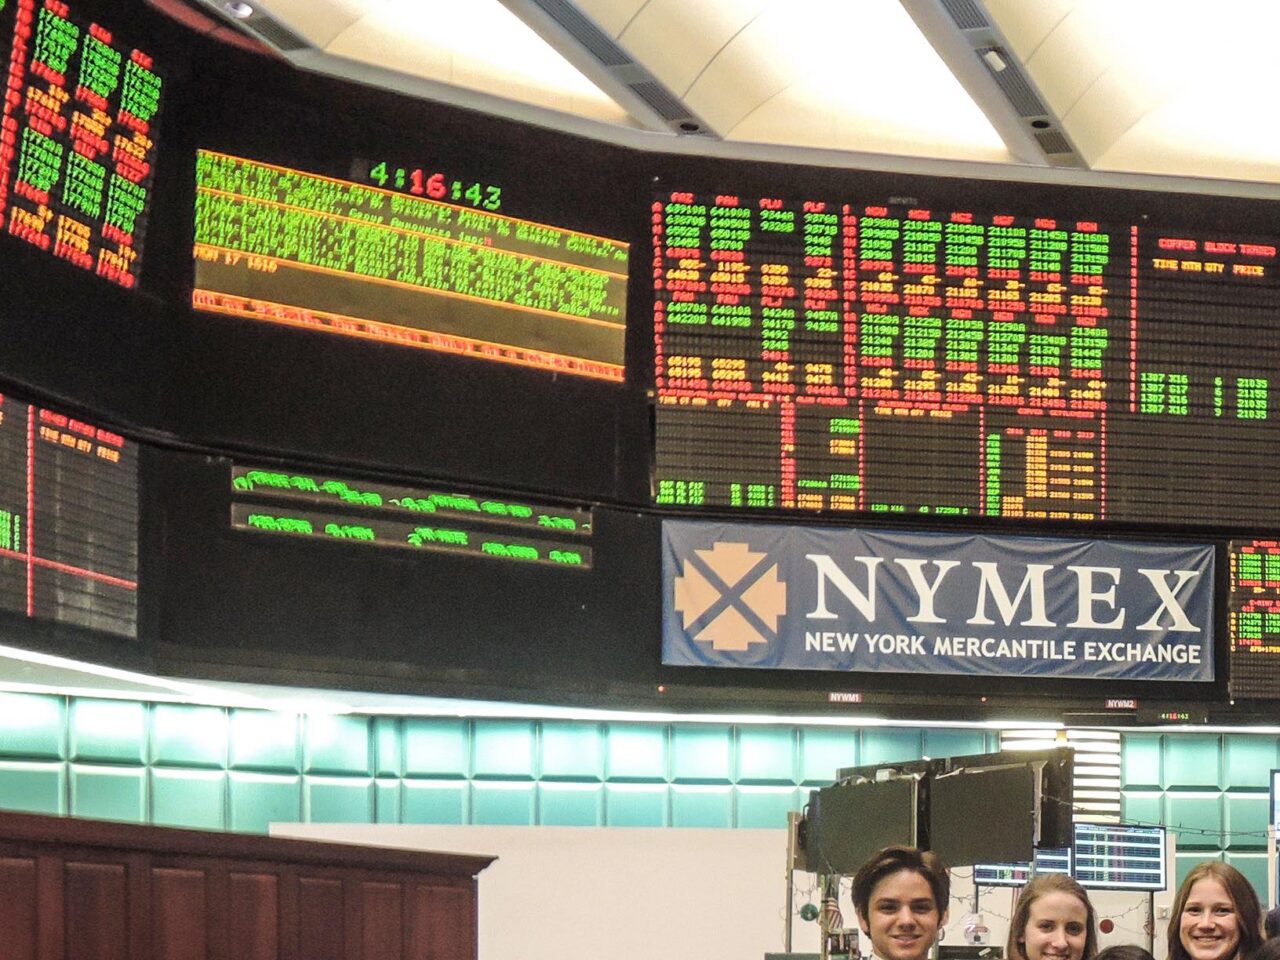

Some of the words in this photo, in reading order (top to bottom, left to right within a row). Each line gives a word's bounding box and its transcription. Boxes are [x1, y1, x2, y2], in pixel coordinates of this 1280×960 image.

[370, 162, 500, 211] 4:16:43
[905, 219, 942, 232] 21015A
[989, 225, 1026, 238] 21110A
[1031, 239, 1068, 251] 21120B
[1072, 242, 1109, 254] 21150B
[904, 251, 936, 264] 21015
[1072, 263, 1103, 275] 21135
[1072, 252, 1108, 265] 21315B
[1152, 258, 1178, 269] TIME
[1233, 264, 1264, 276] PRICE
[762, 329, 789, 341] 9492
[989, 321, 1028, 334] 21290A
[904, 326, 942, 339] 21215B
[946, 329, 984, 341] 21245B
[988, 331, 1026, 344] 21270B
[1071, 336, 1109, 349] 21315B
[861, 334, 892, 347] 21240
[989, 342, 1020, 354] 21345
[1030, 344, 1062, 357] 21370
[1071, 347, 1103, 359] 21445
[862, 345, 893, 357] 21240
[1030, 355, 1061, 367] 21370
[1071, 357, 1102, 369] 21365
[1140, 373, 1165, 383] 1307
[1236, 378, 1268, 388] 21035
[1140, 383, 1165, 392] 1307
[1140, 394, 1165, 403] 1307
[1236, 399, 1268, 409] 21035
[1140, 404, 1165, 413] 1307
[1236, 409, 1267, 420] 21035
[806, 554, 1201, 632] NYMEX
[805, 631, 859, 652] NEW
[864, 633, 926, 656] YORK
[933, 638, 1077, 661] MERCANTILE
[1084, 642, 1202, 664] EXCHANGE
[830, 692, 860, 702] NYWM1
